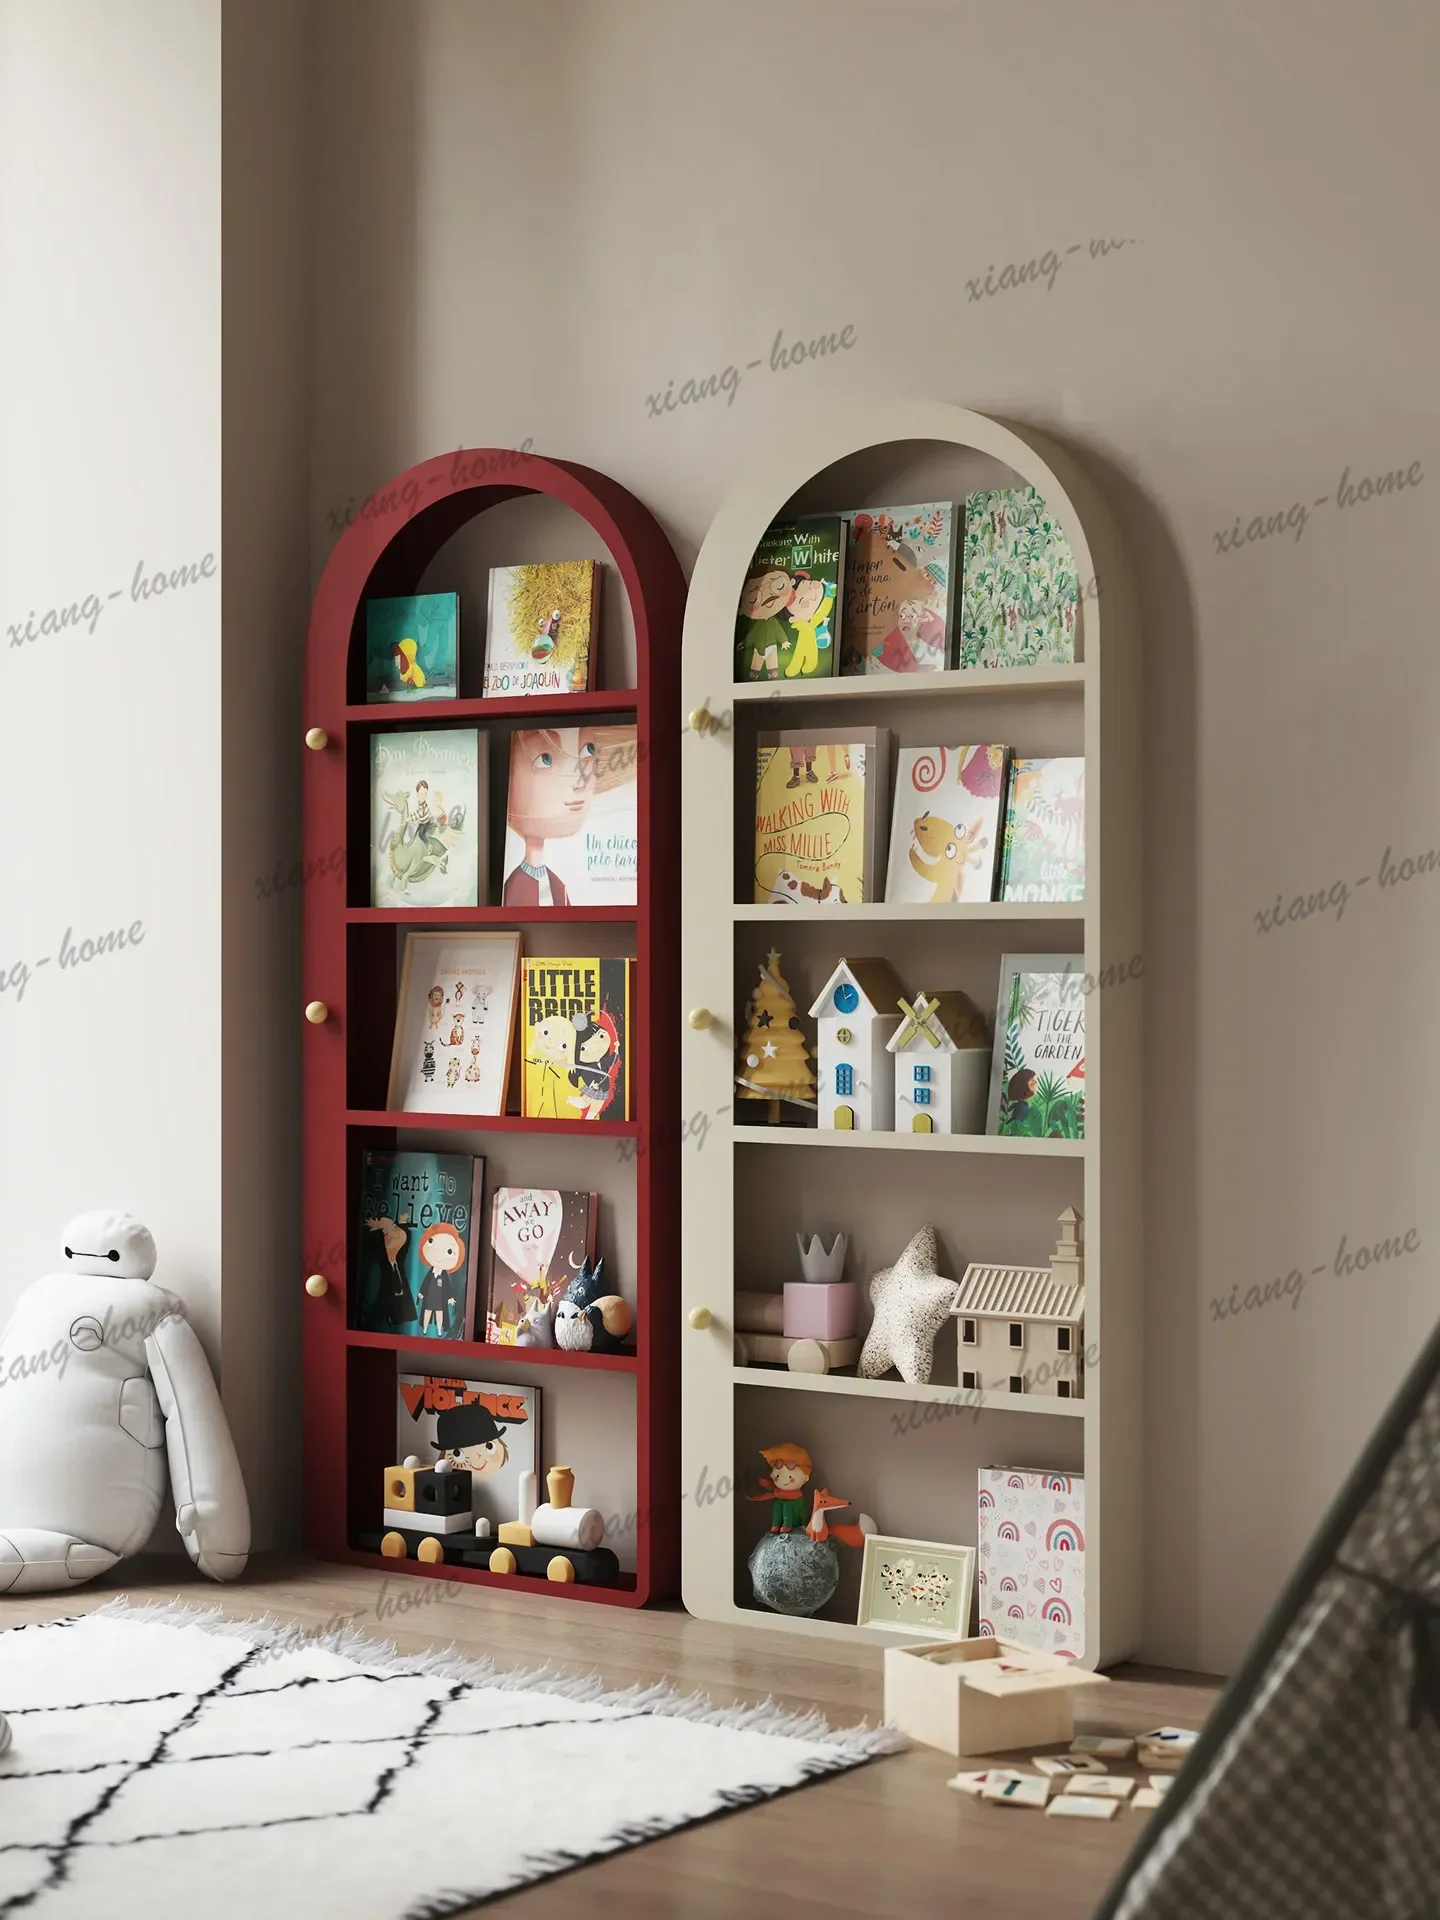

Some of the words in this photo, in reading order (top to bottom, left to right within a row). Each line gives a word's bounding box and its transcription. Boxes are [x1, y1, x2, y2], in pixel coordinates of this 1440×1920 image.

[793, 533, 820, 545] With
[520, 670, 560, 689] JOAQUÍN
[756, 792, 815, 832] WALKING
[820, 787, 851, 815] WITH
[763, 835, 787, 853] MISS
[790, 832, 832, 859] MILLIE
[528, 969, 596, 998] LITTLE
[1056, 1033, 1073, 1044] THE
[1034, 1044, 1083, 1060] GARDEN
[390, 1170, 430, 1192] Want
[438, 1170, 457, 1197] To
[519, 1193, 533, 1203] and
[503, 1201, 553, 1227] AWAY
[517, 1225, 544, 1243] GO
